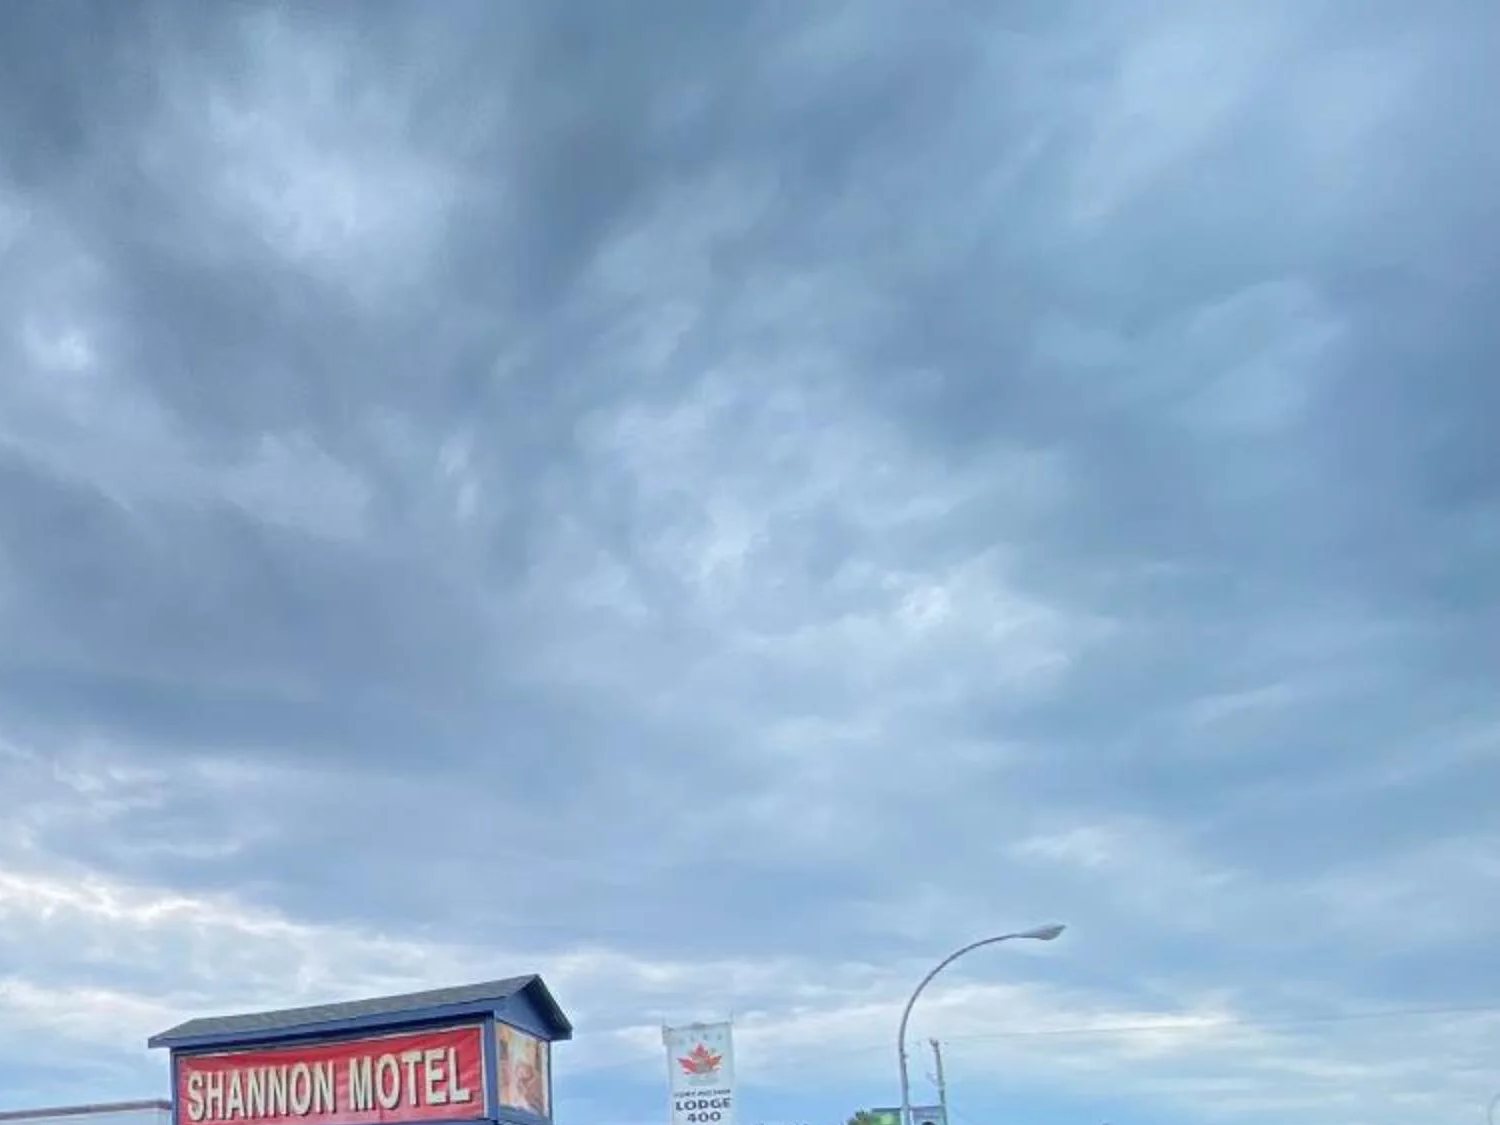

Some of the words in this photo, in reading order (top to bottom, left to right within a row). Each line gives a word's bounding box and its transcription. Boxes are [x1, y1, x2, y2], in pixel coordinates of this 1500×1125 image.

[187, 1059, 337, 1121] SHANNON
[349, 1047, 472, 1111] MOTEL
[675, 1098, 731, 1112] LODGE
[687, 1112, 721, 1123] 400
